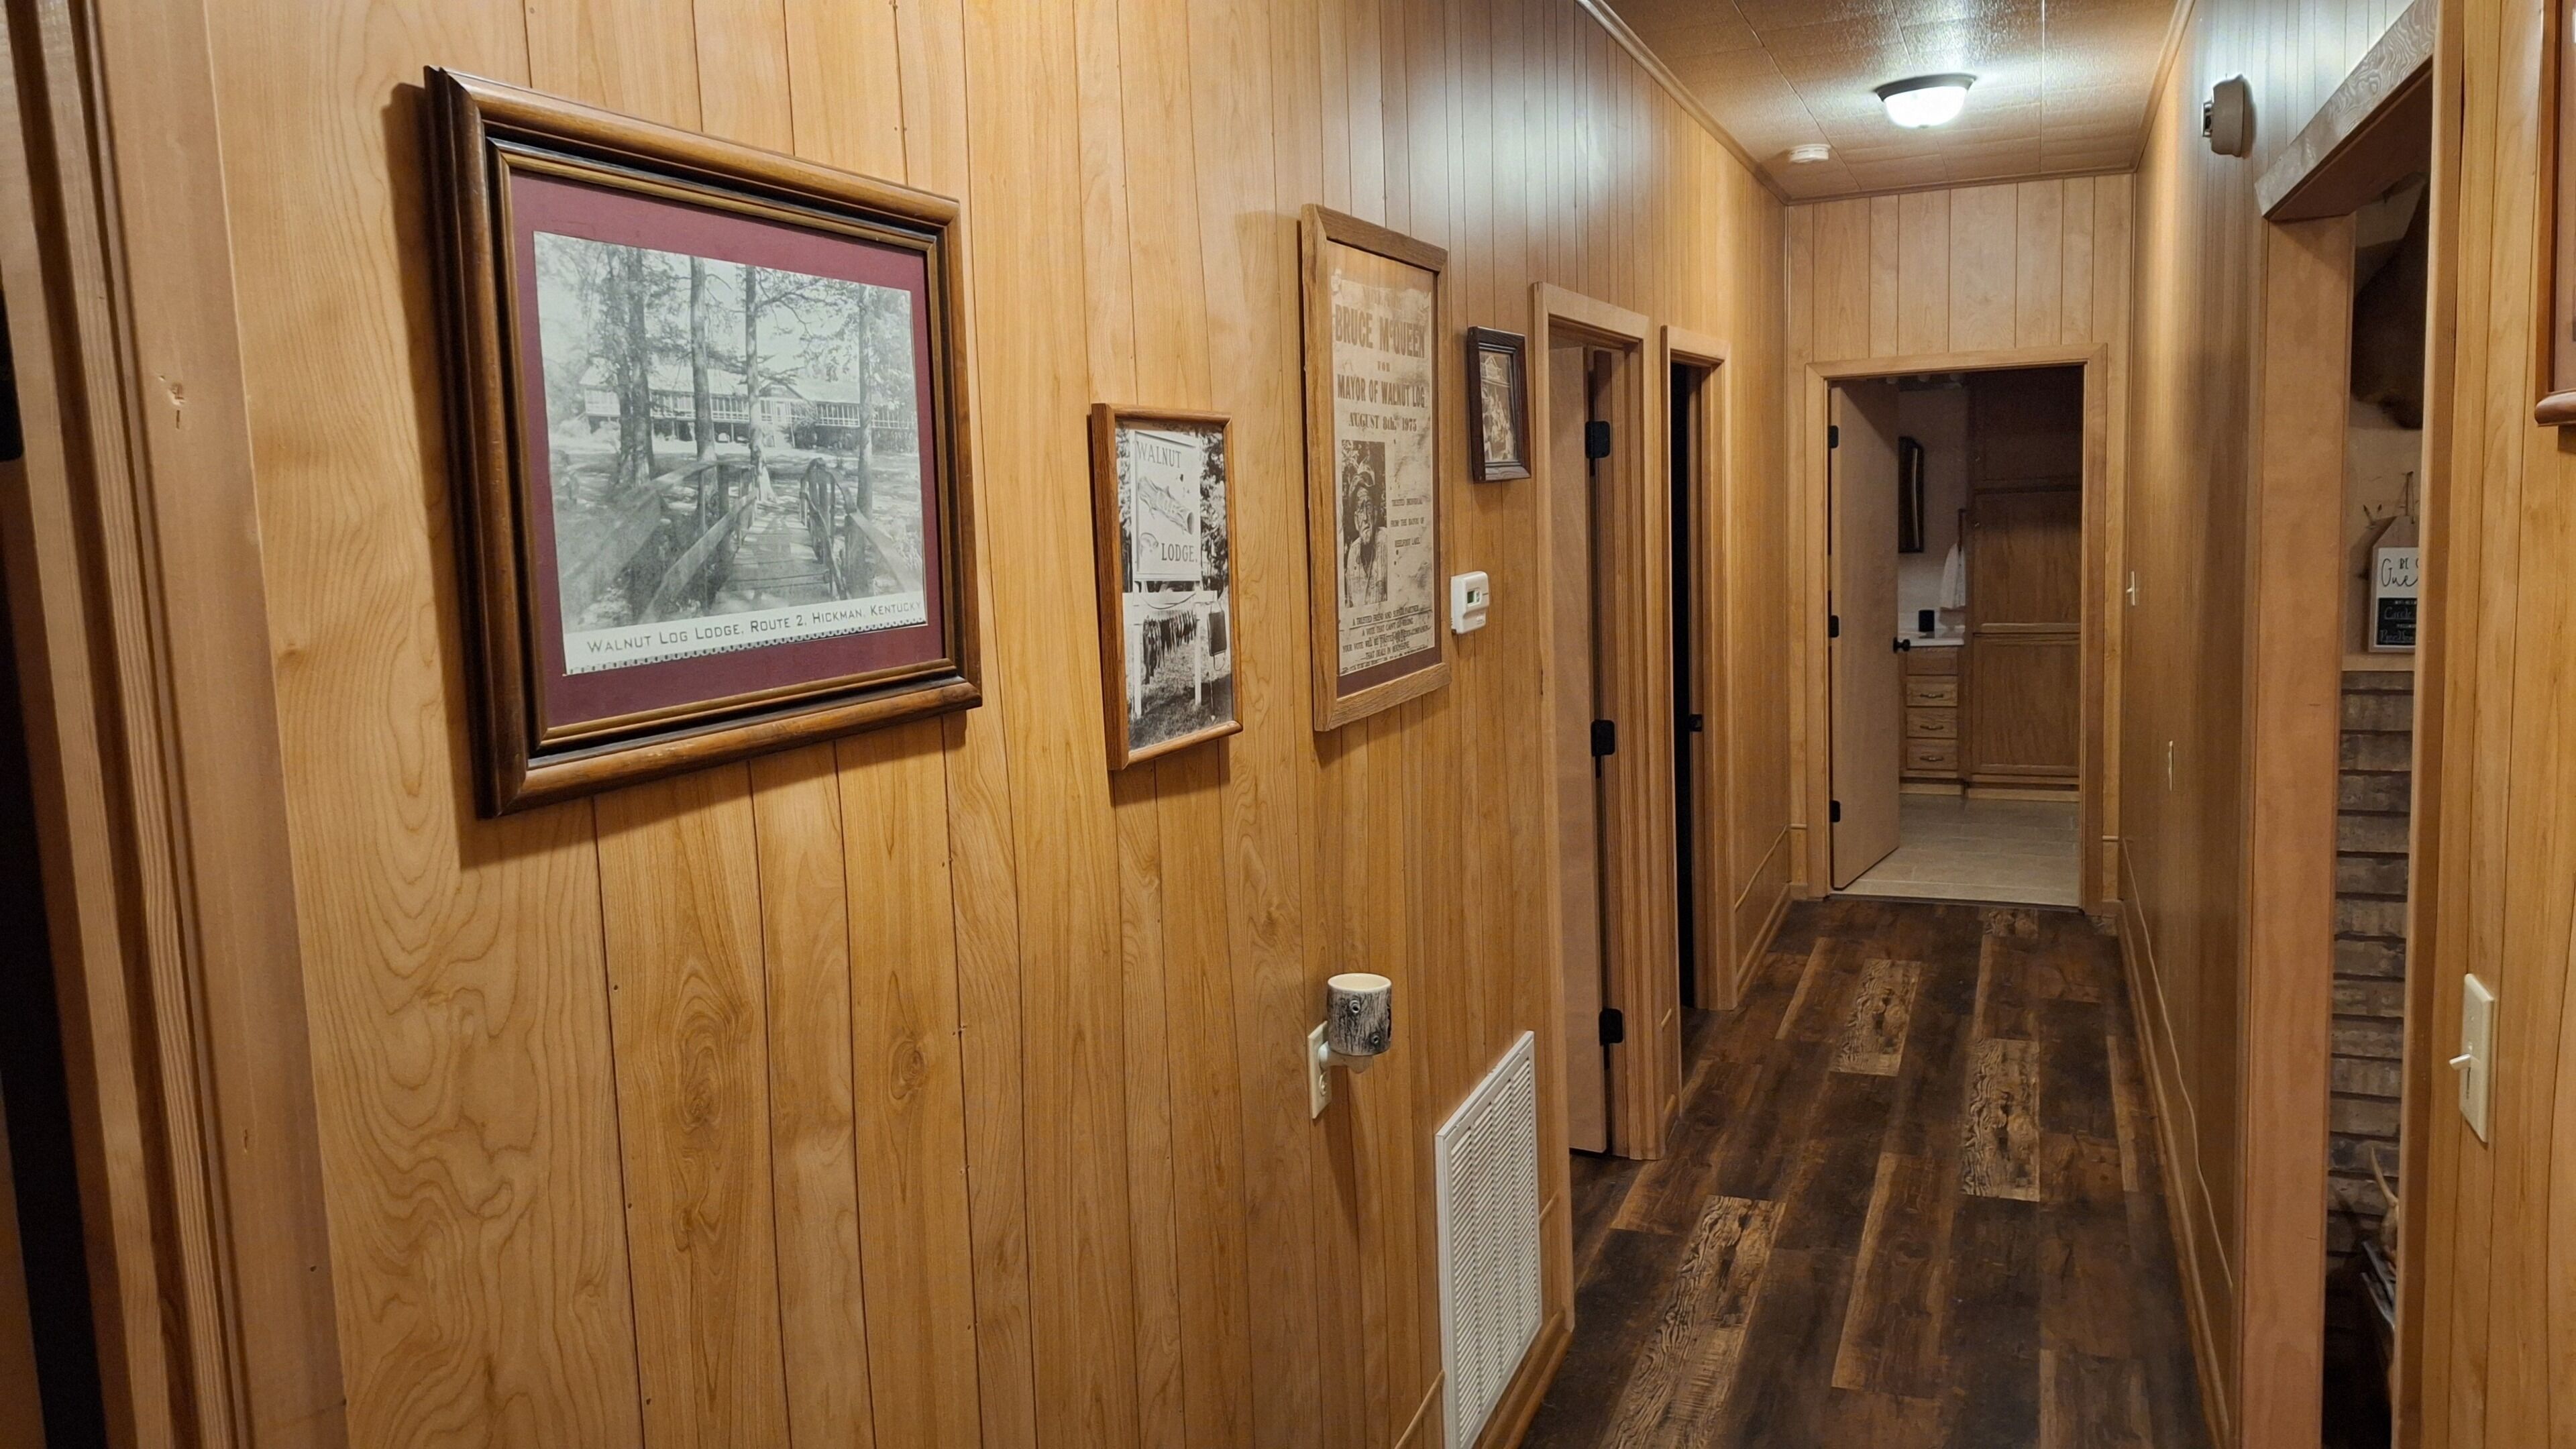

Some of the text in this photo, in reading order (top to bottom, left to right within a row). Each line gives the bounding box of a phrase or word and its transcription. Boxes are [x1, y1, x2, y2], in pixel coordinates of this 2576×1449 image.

[1336, 304, 1425, 358] BRUCE McQUEEN
[1377, 360, 1391, 372] FOR
[1337, 374, 1425, 409] MAYOR OF WALNUT LOG
[1348, 412, 1380, 429] AUGUST
[1136, 441, 1181, 468] WALNUT
[2381, 557, 2418, 587] Gue
[659, 631, 688, 645] LOG
[750, 617, 790, 633] ROUTE
[871, 600, 922, 616] KENTUCKY
